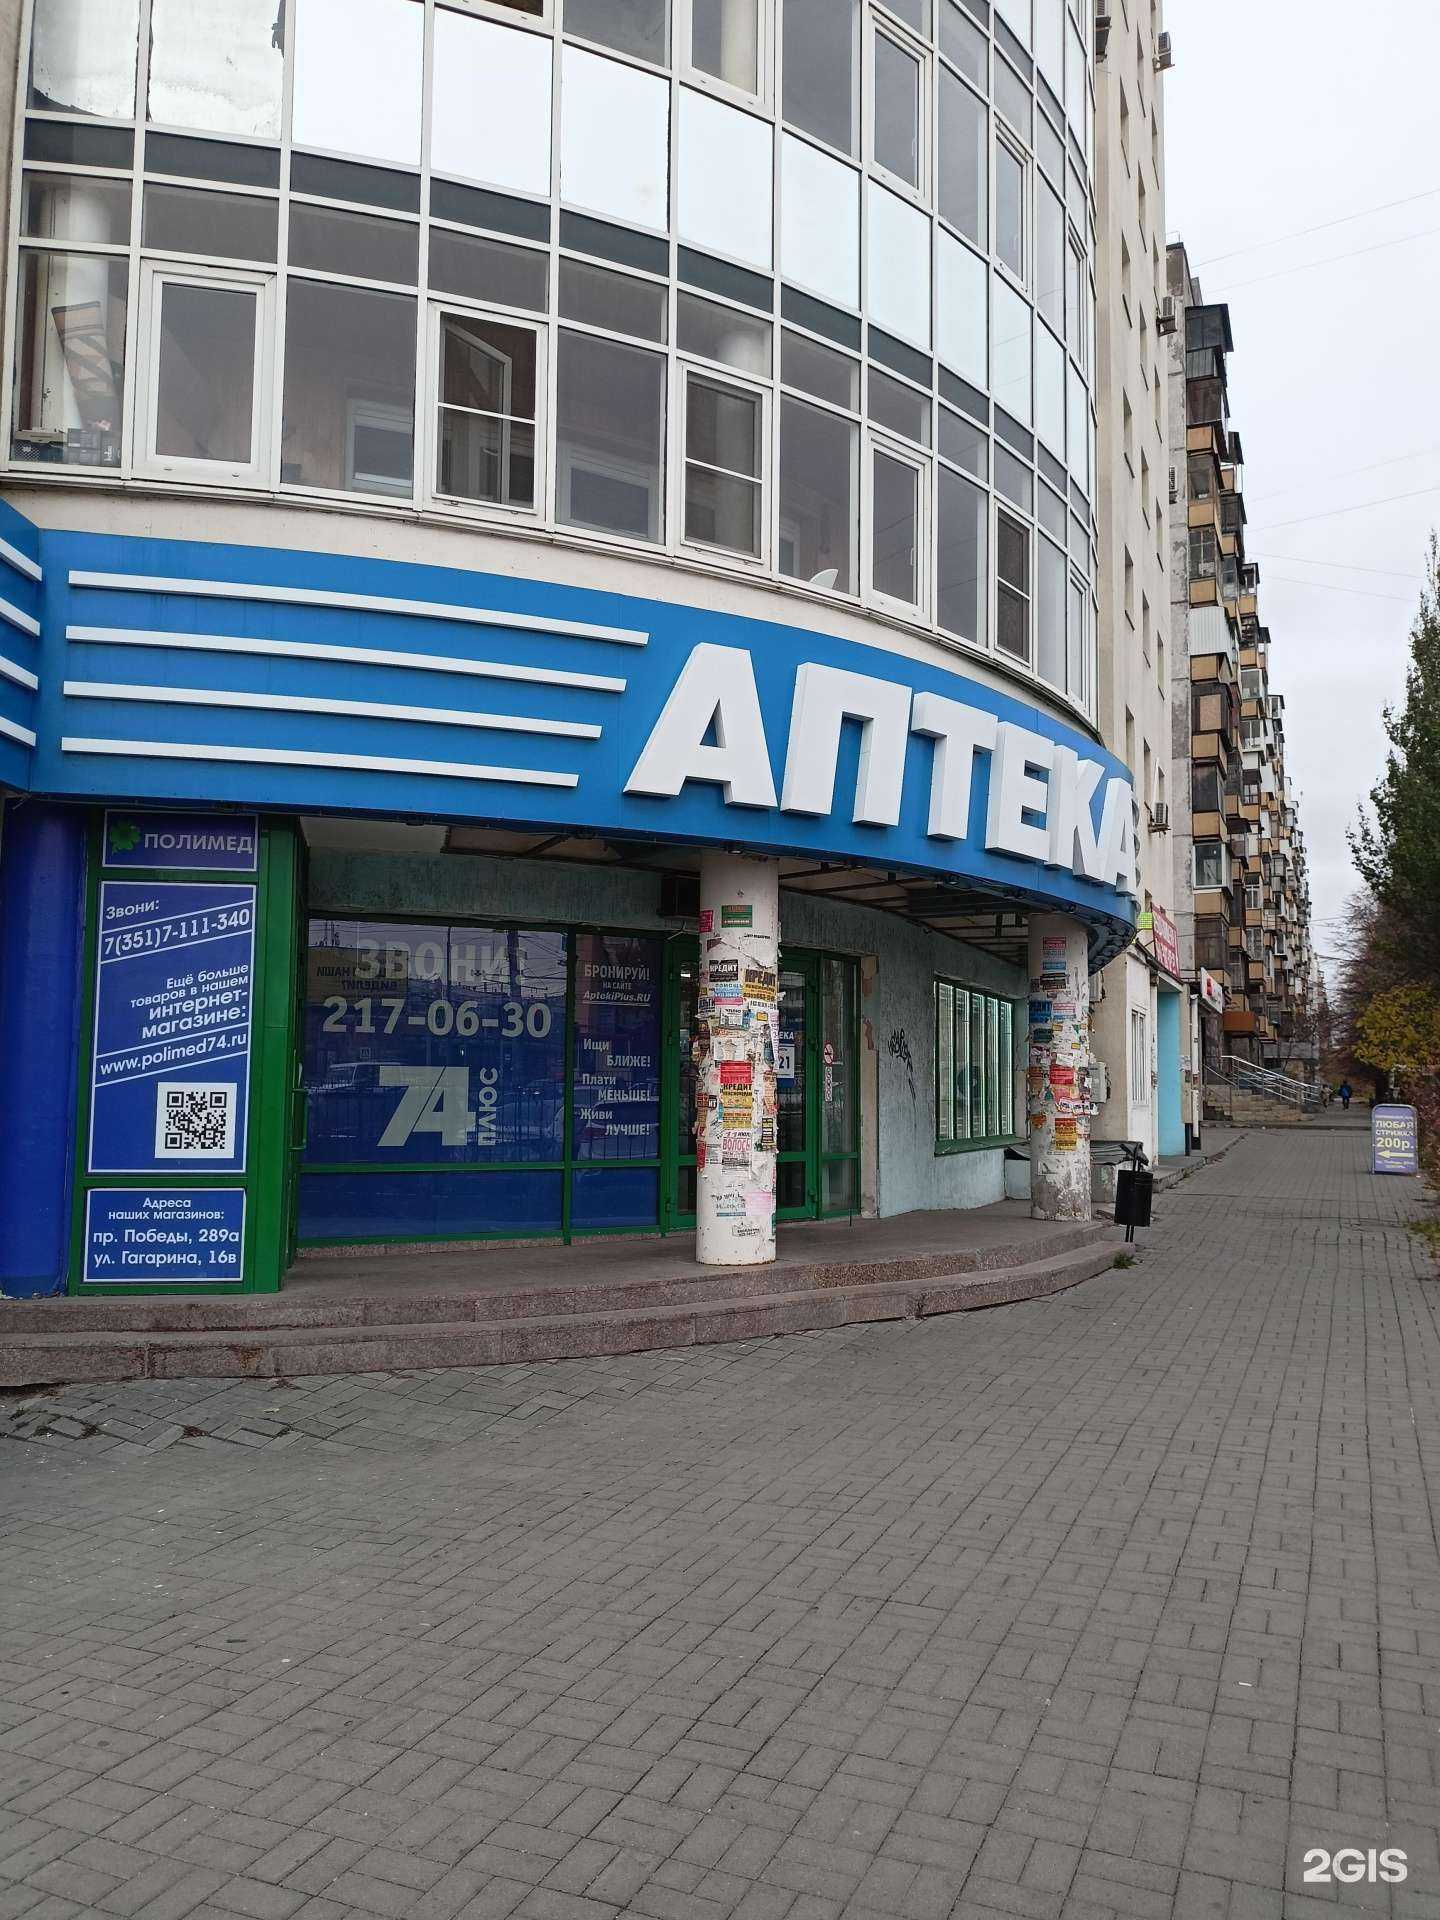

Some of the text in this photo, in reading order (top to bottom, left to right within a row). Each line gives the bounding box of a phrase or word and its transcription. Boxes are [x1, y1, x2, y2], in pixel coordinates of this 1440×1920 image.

[622, 641, 1137, 896] АПТЕКА
[143, 832, 254, 854] ПОЛИМЕД
[105, 899, 161, 921] Звони:
[104, 908, 251, 957] 7(351)7-111-340
[583, 963, 651, 982] БРОНИРУЙ!
[709, 963, 738, 973] КРЕДИТ
[166, 963, 249, 990] Ещё больше
[130, 975, 249, 1009] товаров в нашем
[148, 989, 249, 1021] интернет-
[141, 1005, 247, 1040] магазине:
[322, 995, 552, 1038] 217-06-30
[583, 1038, 610, 1051] Ищи
[100, 1032, 247, 1076] www.polimed74.ru
[606, 1055, 651, 1067] БЛИЖЕ!
[582, 1073, 617, 1086] Плати
[723, 1083, 753, 1092] КРЕДИТ
[598, 1089, 651, 1102] МЕНЬШЕ!
[579, 1108, 613, 1120] Живи
[604, 1123, 651, 1136] ЛУЧШЕ!
[1375, 1120, 1414, 1129] ЛЮБАЯ
[722, 1138, 753, 1151] ВОЛОСЫ
[1376, 1137, 1414, 1150] 200р.
[142, 1197, 192, 1210] Адреса
[107, 1210, 225, 1221] наших магазинов:
[92, 1228, 240, 1245] пр. Победы, 289а
[93, 1250, 237, 1268] ул. Гагарина, 16в
